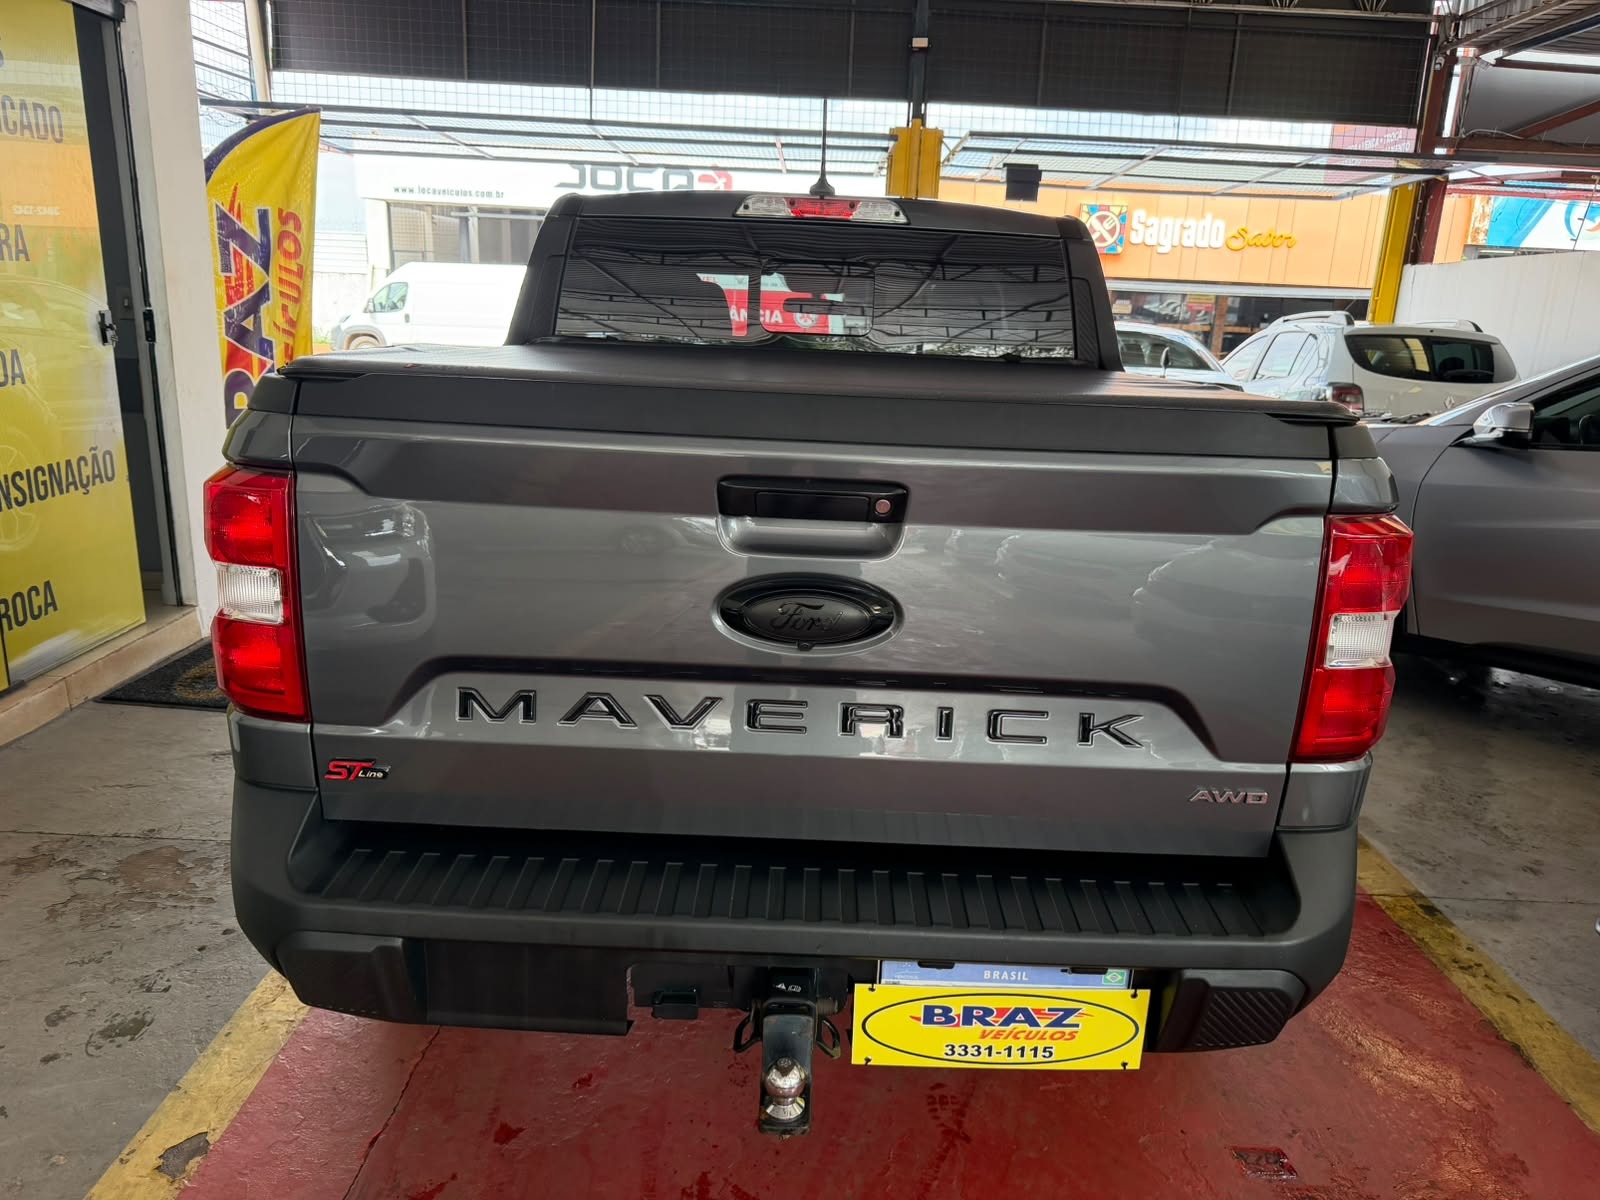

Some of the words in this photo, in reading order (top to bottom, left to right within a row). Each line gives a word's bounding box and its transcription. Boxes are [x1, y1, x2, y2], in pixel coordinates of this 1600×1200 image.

[0, 95, 64, 144] CADO
[1129, 208, 1226, 253] Sagrado
[771, 602, 843, 632] Ford
[456, 686, 1144, 749] MAVERICK
[324, 760, 375, 781] ST
[358, 770, 384, 779] Line
[1189, 789, 1269, 805] AWD
[983, 970, 1029, 982] BRASIL
[920, 1004, 1085, 1029] BRAZ
[978, 1029, 1080, 1042] VEÍCULOS
[943, 1043, 1055, 1059] 3331-1115
